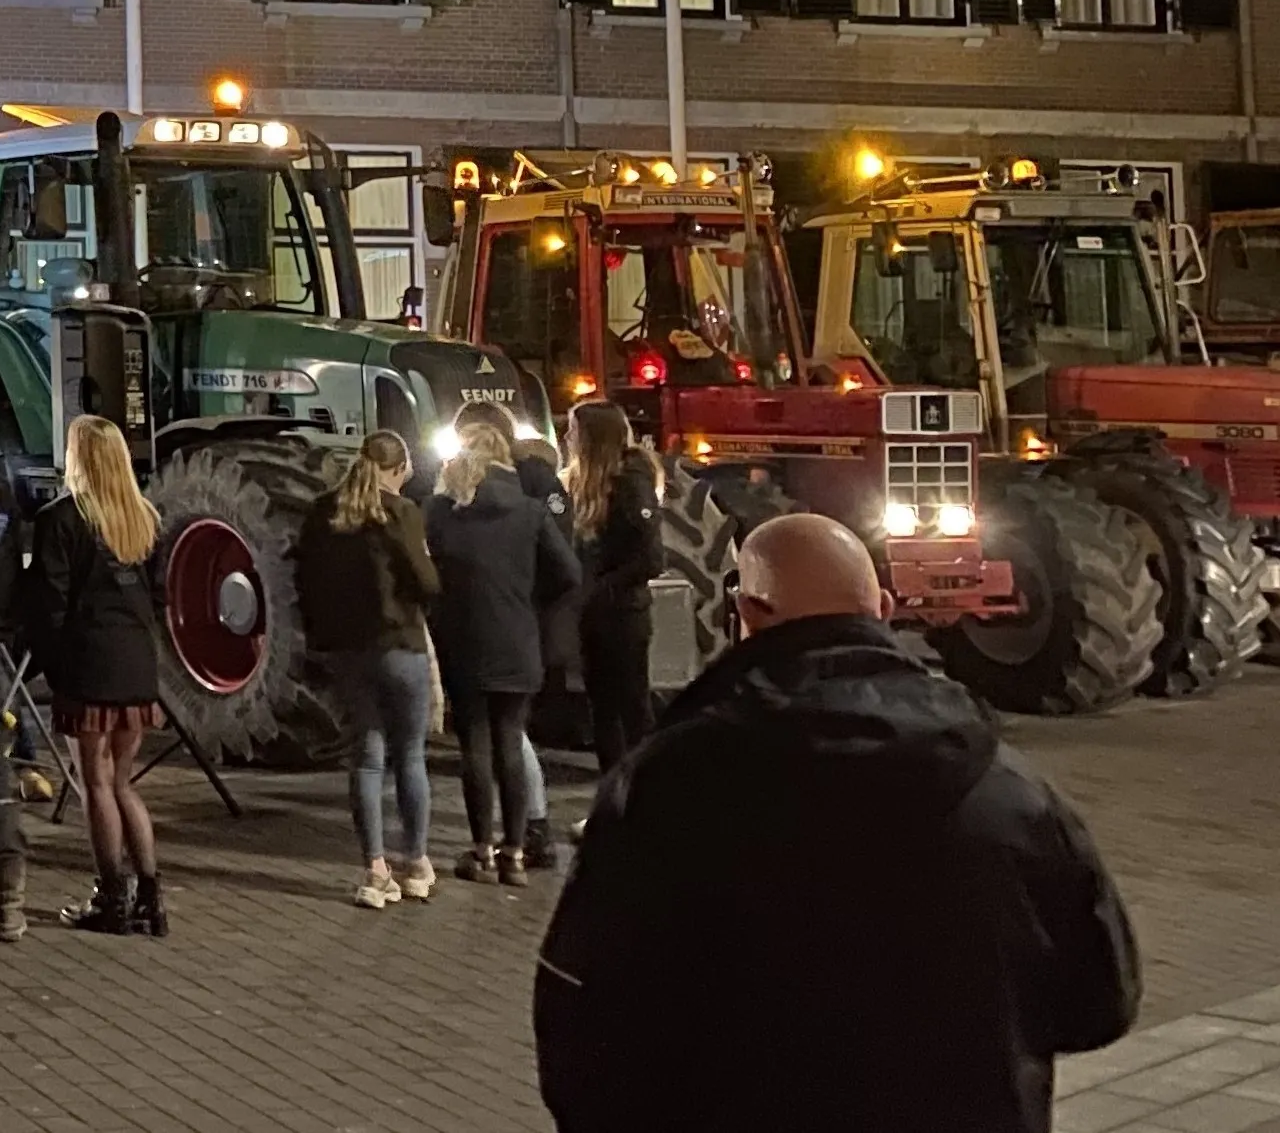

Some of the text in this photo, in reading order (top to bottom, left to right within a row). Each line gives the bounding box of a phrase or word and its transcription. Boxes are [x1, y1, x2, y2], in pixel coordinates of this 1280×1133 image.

[642, 195, 731, 207] INTERNATIONAL
[192, 373, 237, 387] FENDT
[243, 375, 268, 388] 716
[460, 388, 516, 403] FENDT
[1215, 424, 1265, 439] 3080
